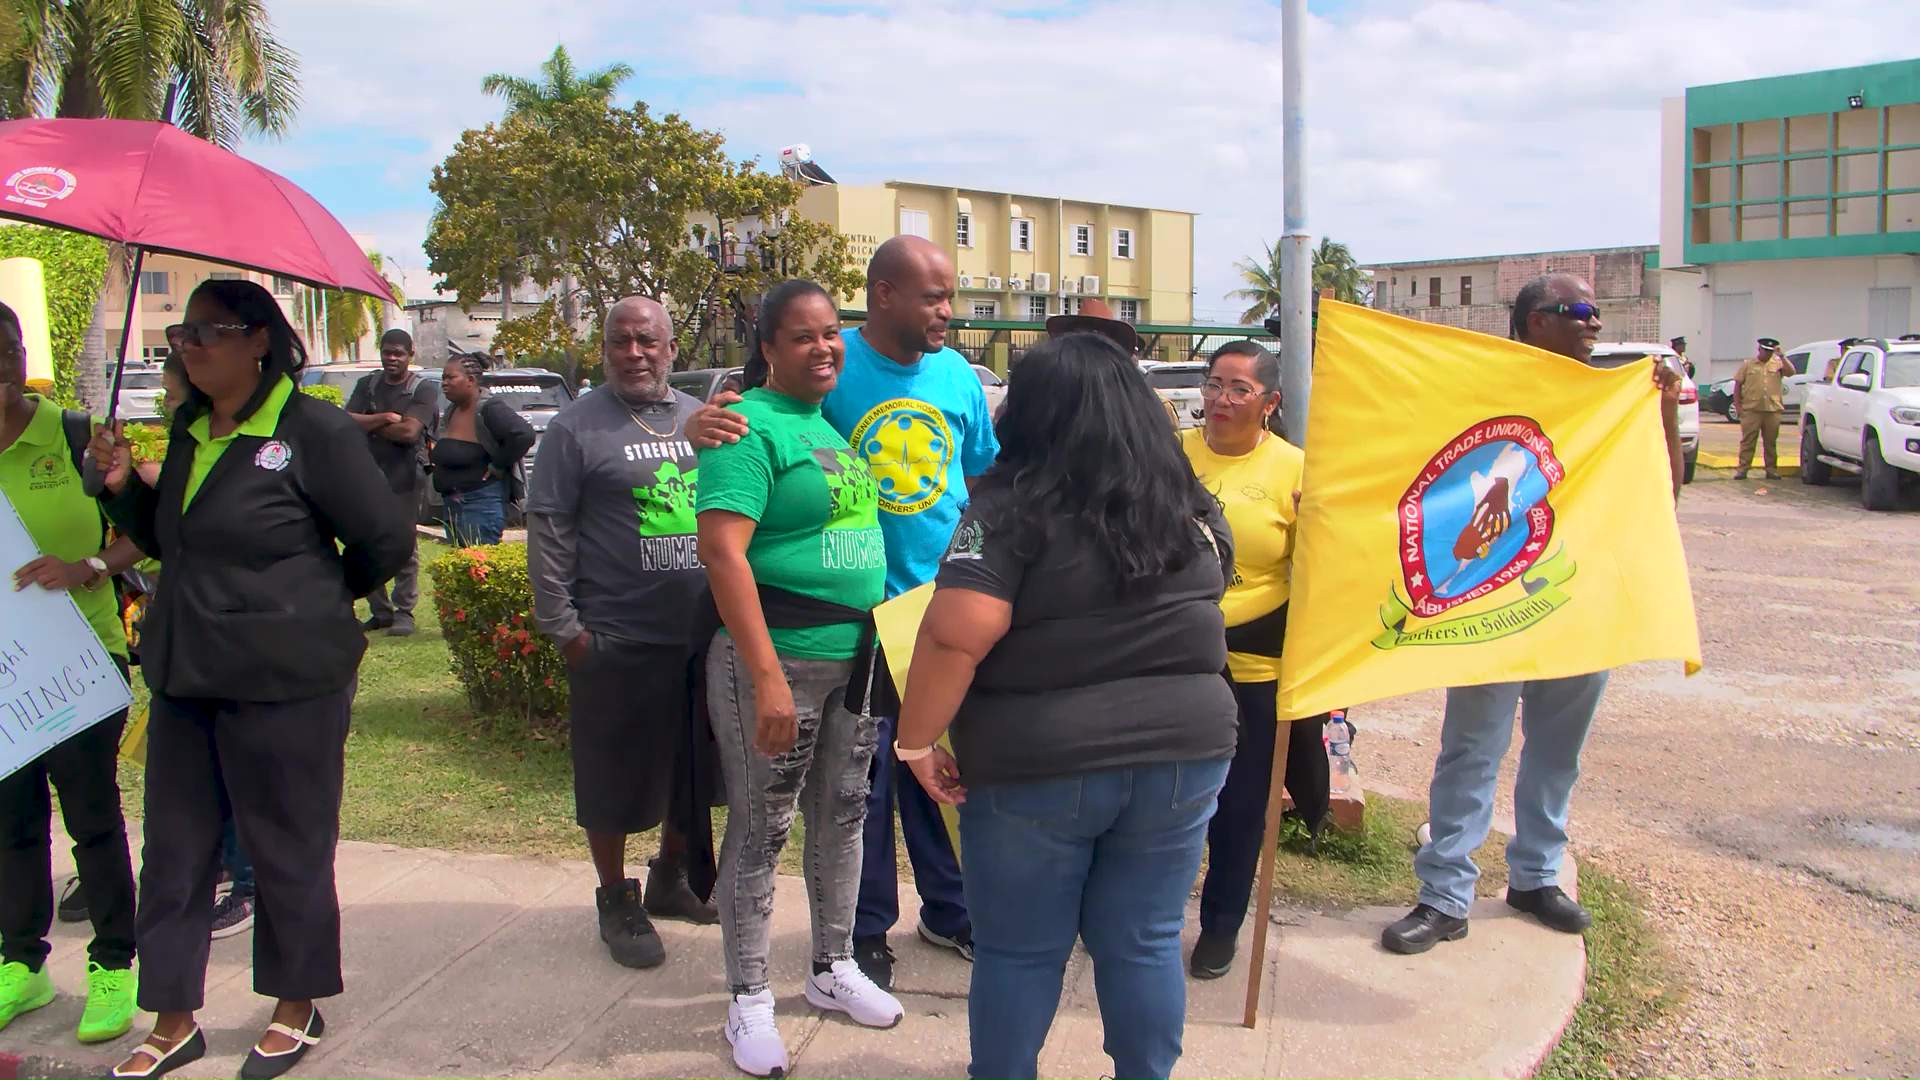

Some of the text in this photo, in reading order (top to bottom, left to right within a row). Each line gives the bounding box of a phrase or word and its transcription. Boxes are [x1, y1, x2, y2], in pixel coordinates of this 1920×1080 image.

[844, 233, 879, 245] NTRAL
[852, 414, 875, 449] HEUSNER
[873, 401, 913, 416] MEMORIAL
[878, 488, 942, 513] ORKERS' UNION
[1405, 472, 1437, 562] NATIONAL
[1435, 430, 1483, 471] TRADE
[1486, 423, 1525, 440] UNION
[641, 535, 706, 571] NUMB
[1495, 559, 1528, 584] 1966
[1463, 621, 1478, 637] in
[1481, 598, 1552, 634] Solidarity
